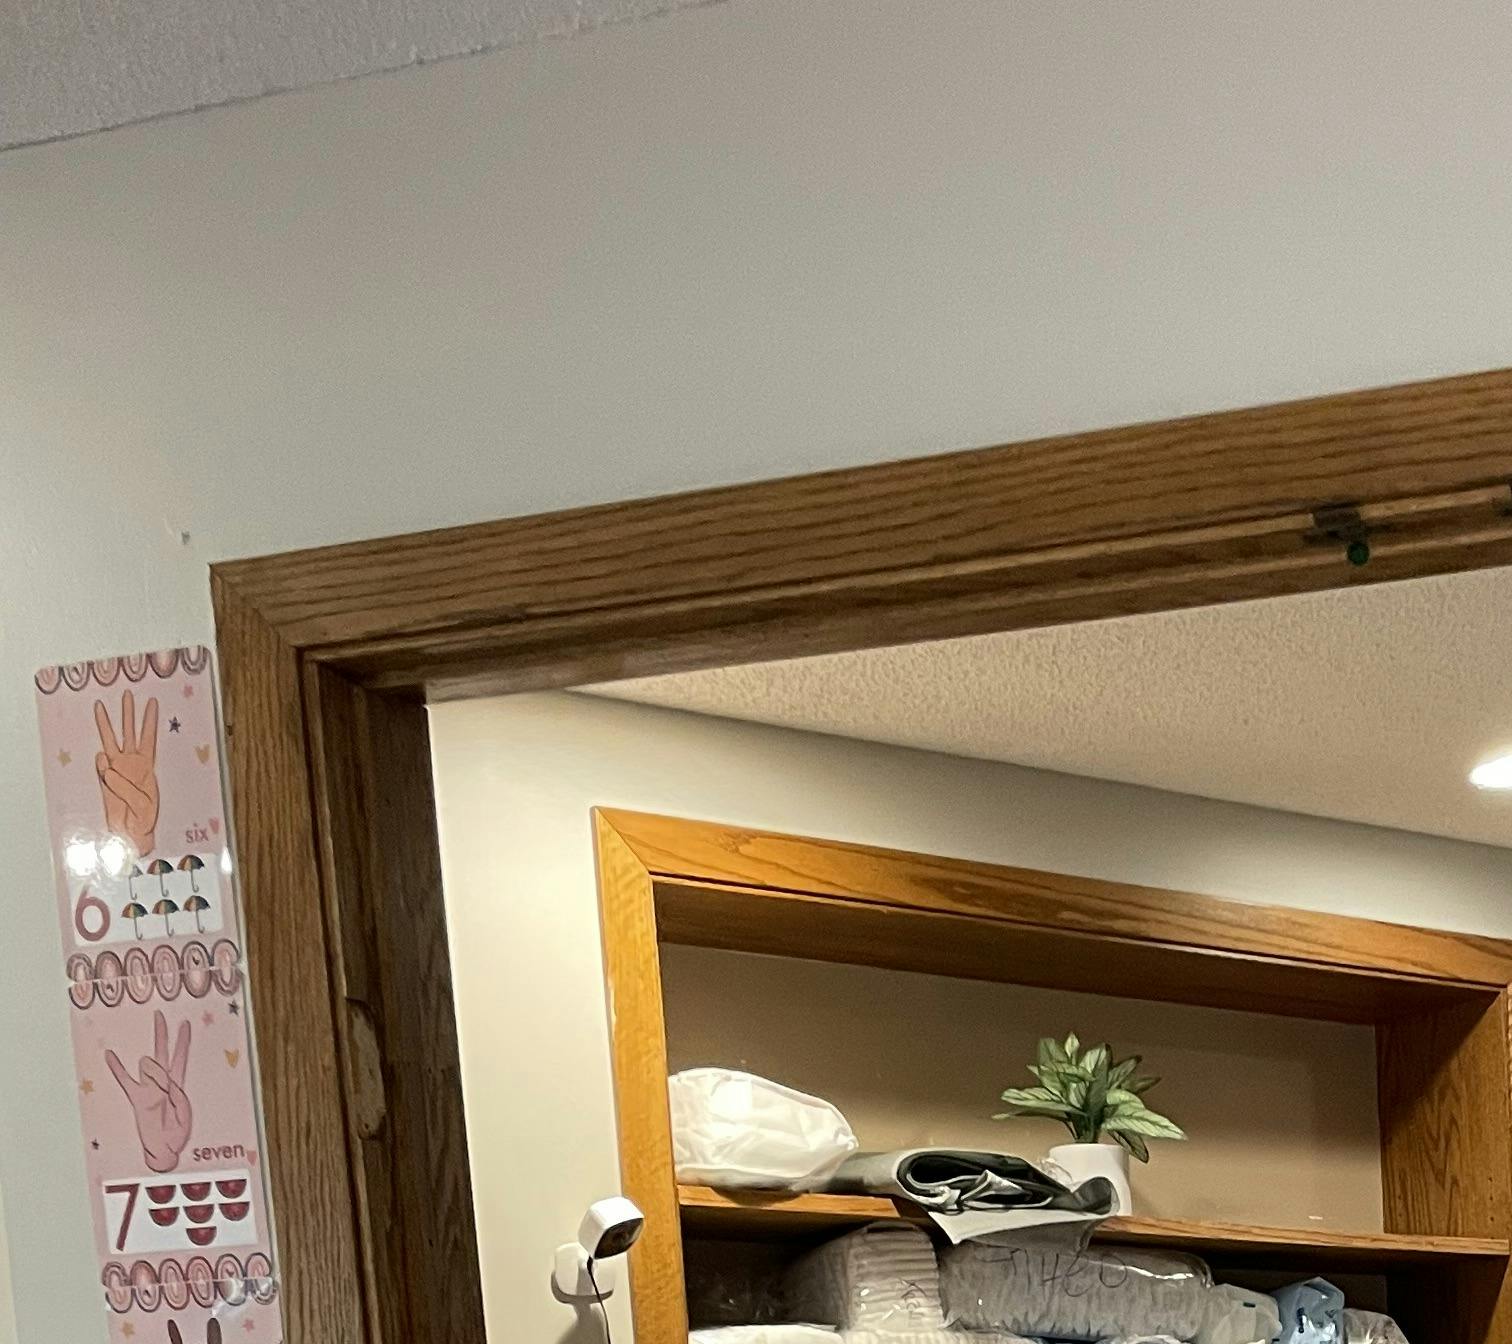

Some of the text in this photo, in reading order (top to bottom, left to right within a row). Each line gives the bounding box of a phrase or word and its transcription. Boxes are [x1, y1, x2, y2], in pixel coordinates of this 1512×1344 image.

[185, 822, 209, 844] six
[75, 886, 111, 942] 6
[193, 1144, 245, 1162] seven
[104, 1183, 141, 1252] 7
